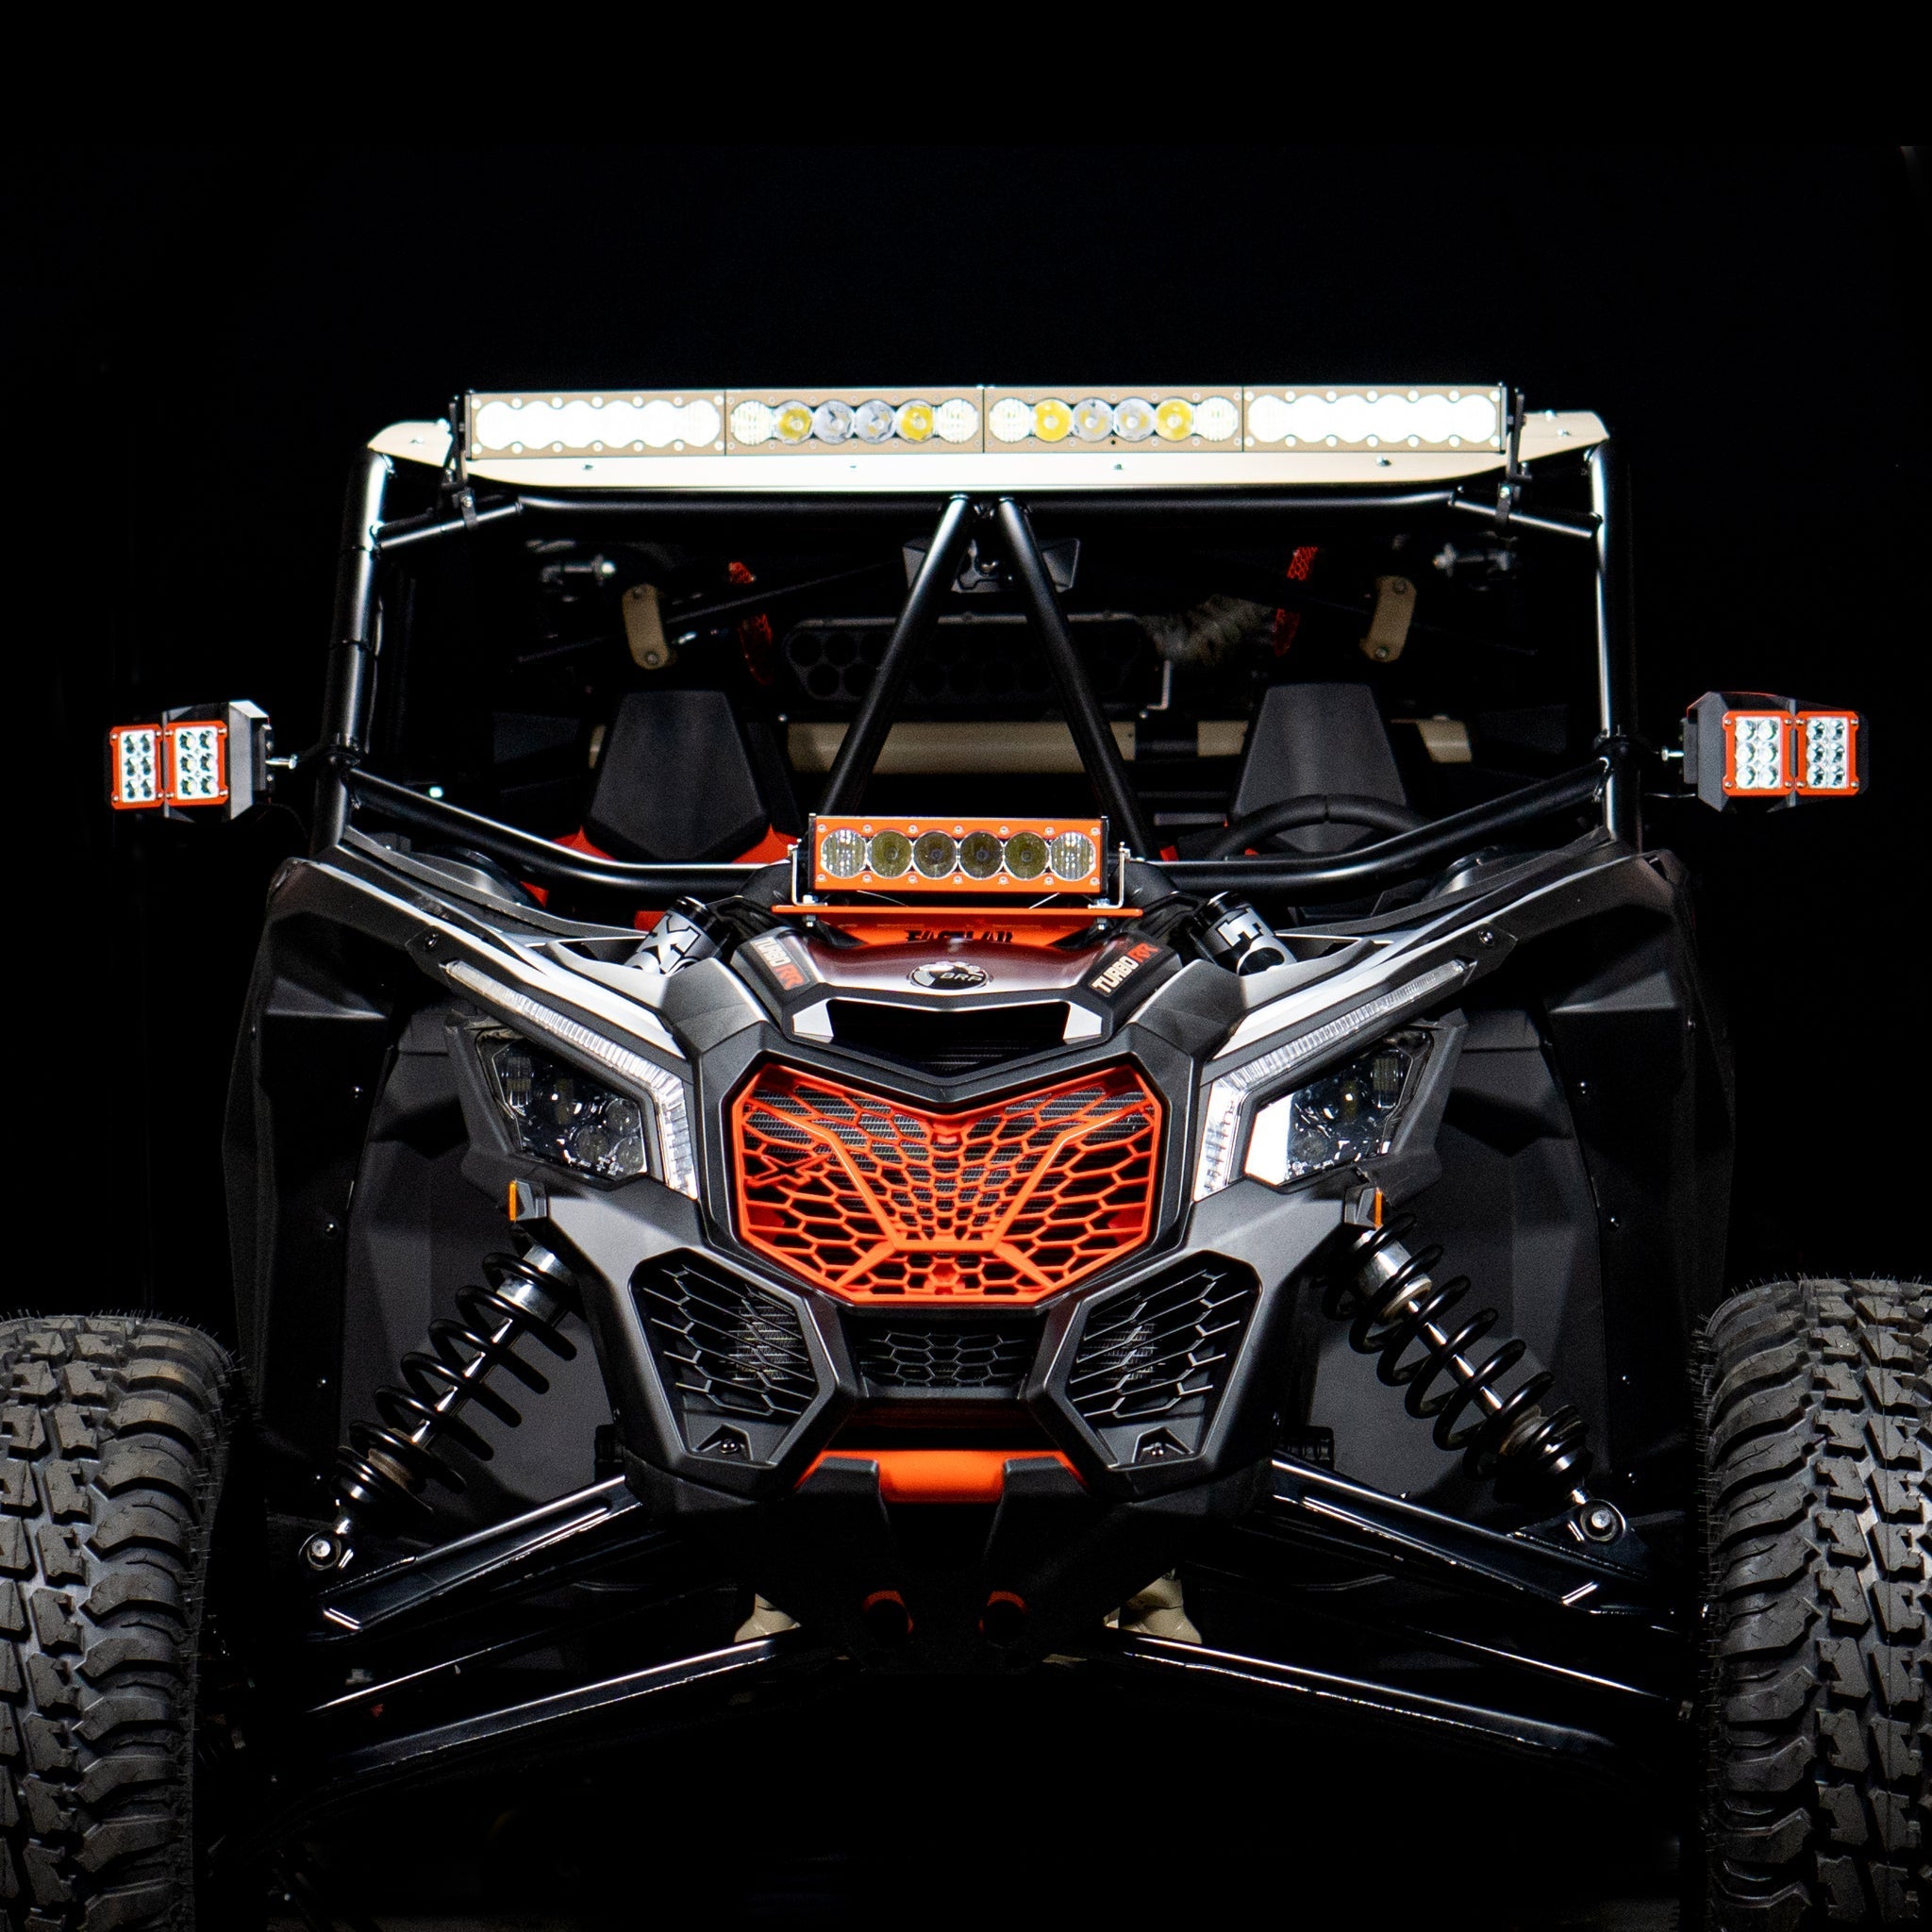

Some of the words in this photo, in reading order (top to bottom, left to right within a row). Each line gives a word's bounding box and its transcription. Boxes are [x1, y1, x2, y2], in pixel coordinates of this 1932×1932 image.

[749, 936, 791, 968] TURBO
[940, 971, 983, 983] BRP
[1091, 955, 1140, 993] TURBO
